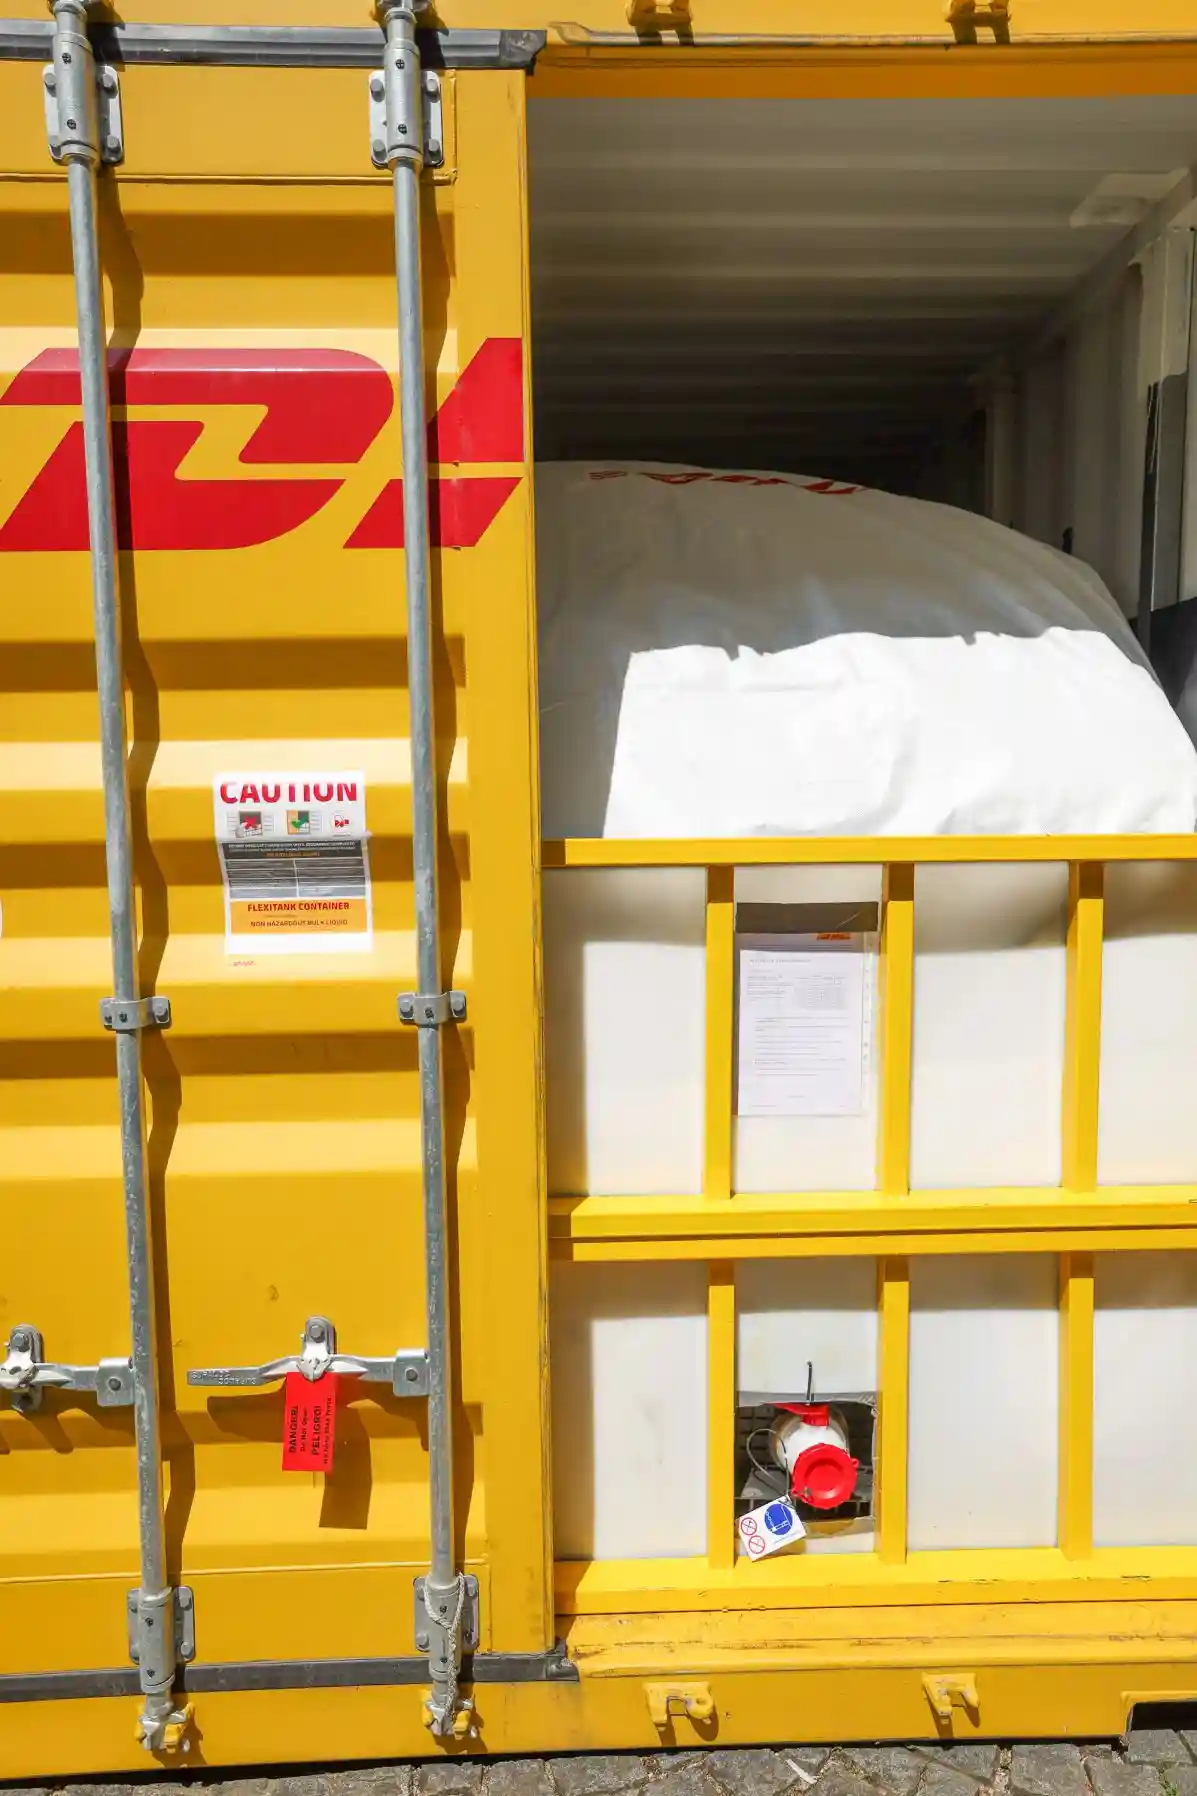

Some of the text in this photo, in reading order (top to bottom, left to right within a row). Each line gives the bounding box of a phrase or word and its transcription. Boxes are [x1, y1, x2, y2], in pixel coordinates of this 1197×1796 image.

[220, 781, 357, 804] CAUTION
[247, 902, 350, 912] FLEXITANK CONTAINER
